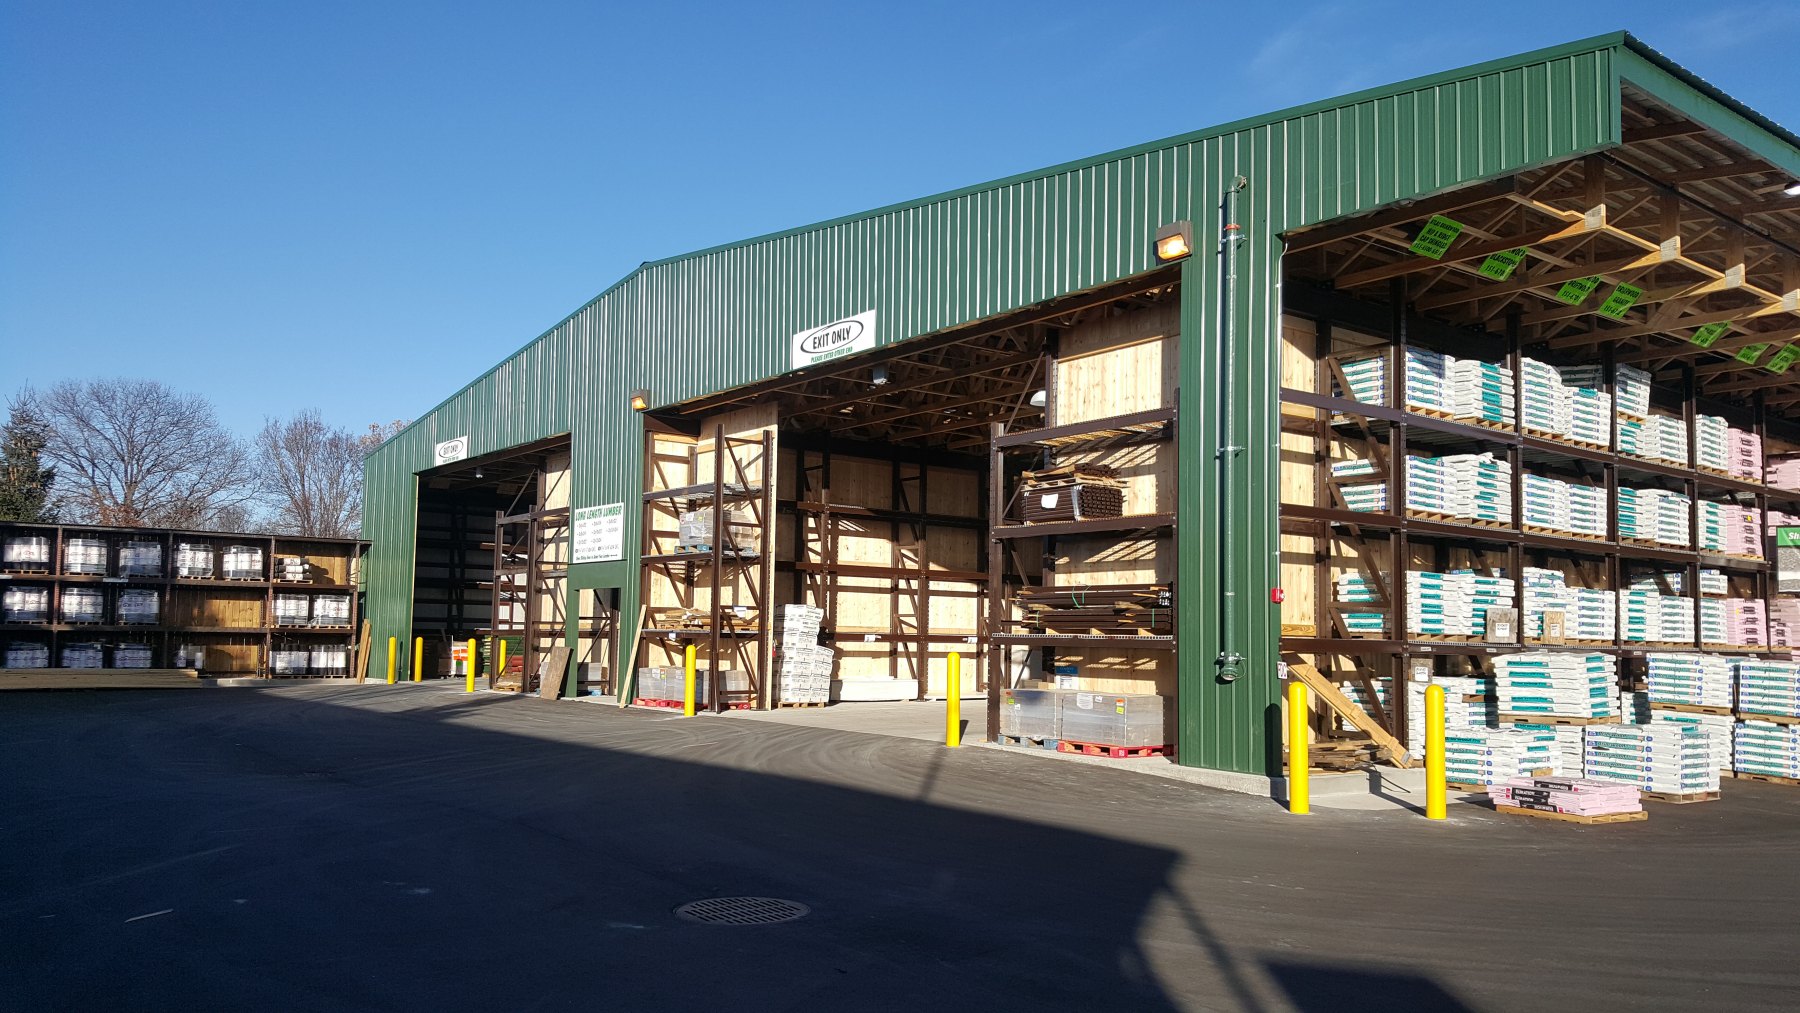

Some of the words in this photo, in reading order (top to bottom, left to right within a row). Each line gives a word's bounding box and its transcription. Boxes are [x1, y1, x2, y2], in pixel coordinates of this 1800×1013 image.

[813, 332, 829, 350] EXIT
[832, 325, 851, 344] ONLY
[587, 508, 602, 520] LENGTH
[603, 505, 622, 517] LUMBER
